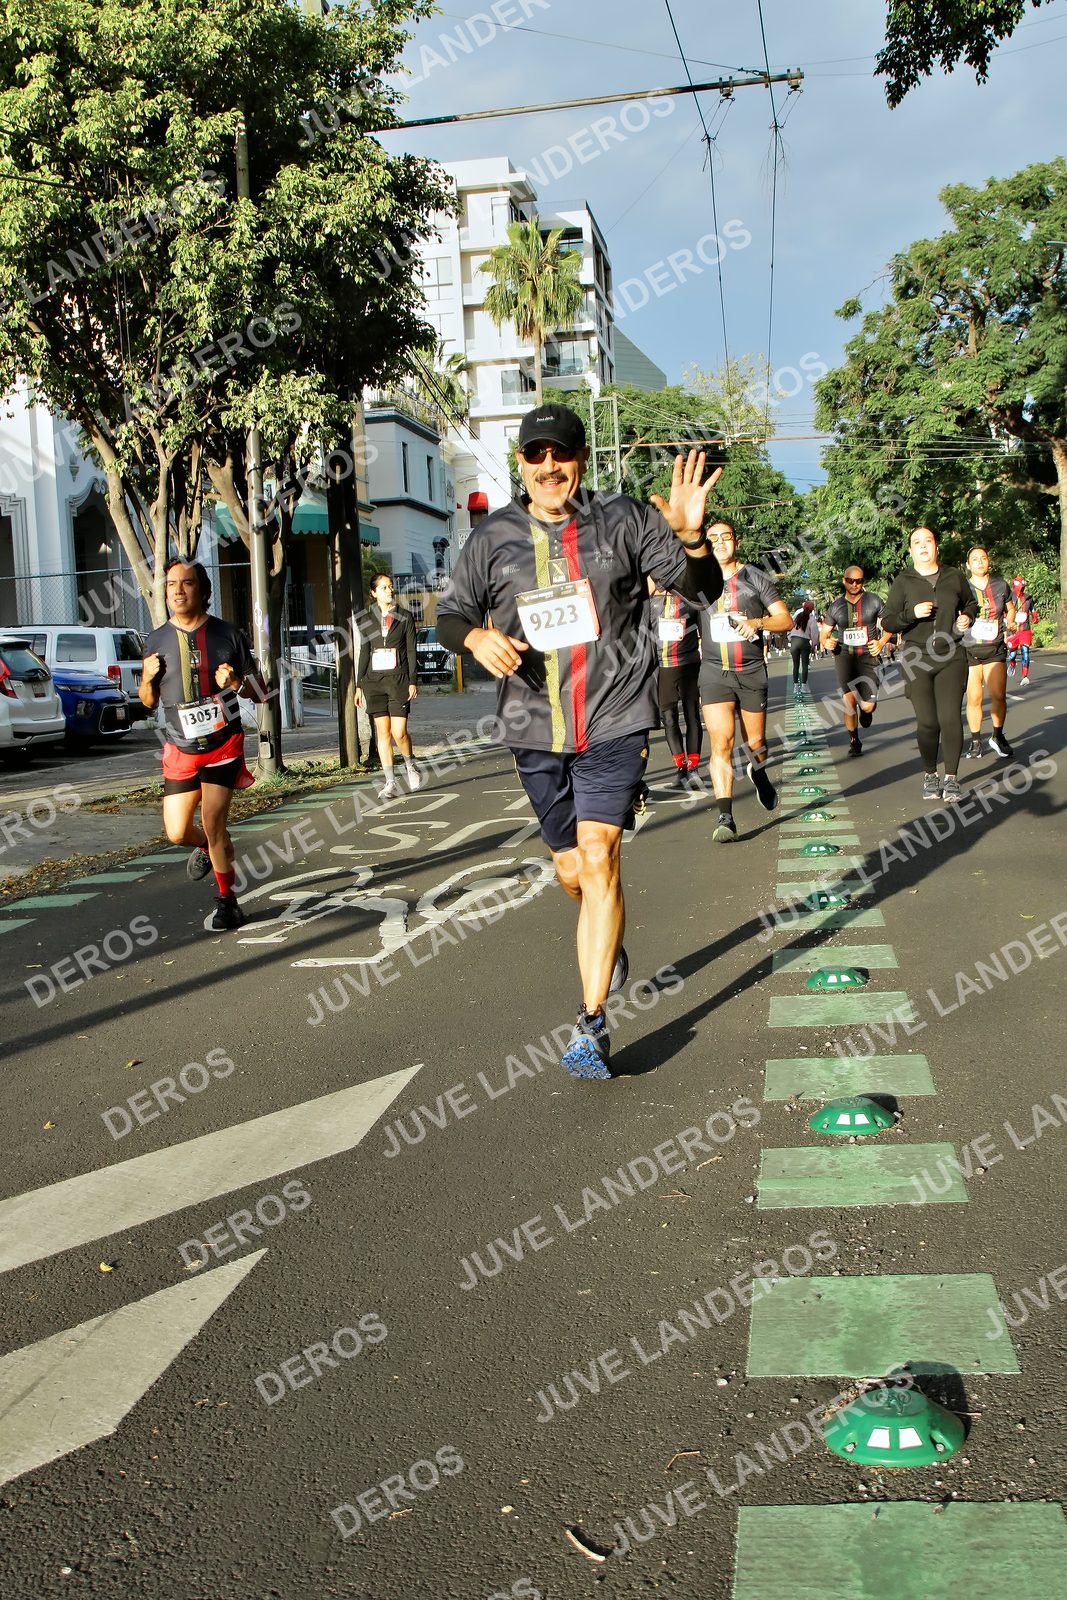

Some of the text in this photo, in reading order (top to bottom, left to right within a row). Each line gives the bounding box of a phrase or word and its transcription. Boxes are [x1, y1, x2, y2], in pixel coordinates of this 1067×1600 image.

[529, 604, 579, 632] 9223
[182, 706, 219, 726] 13057
[362, 782, 712, 817] SLO
